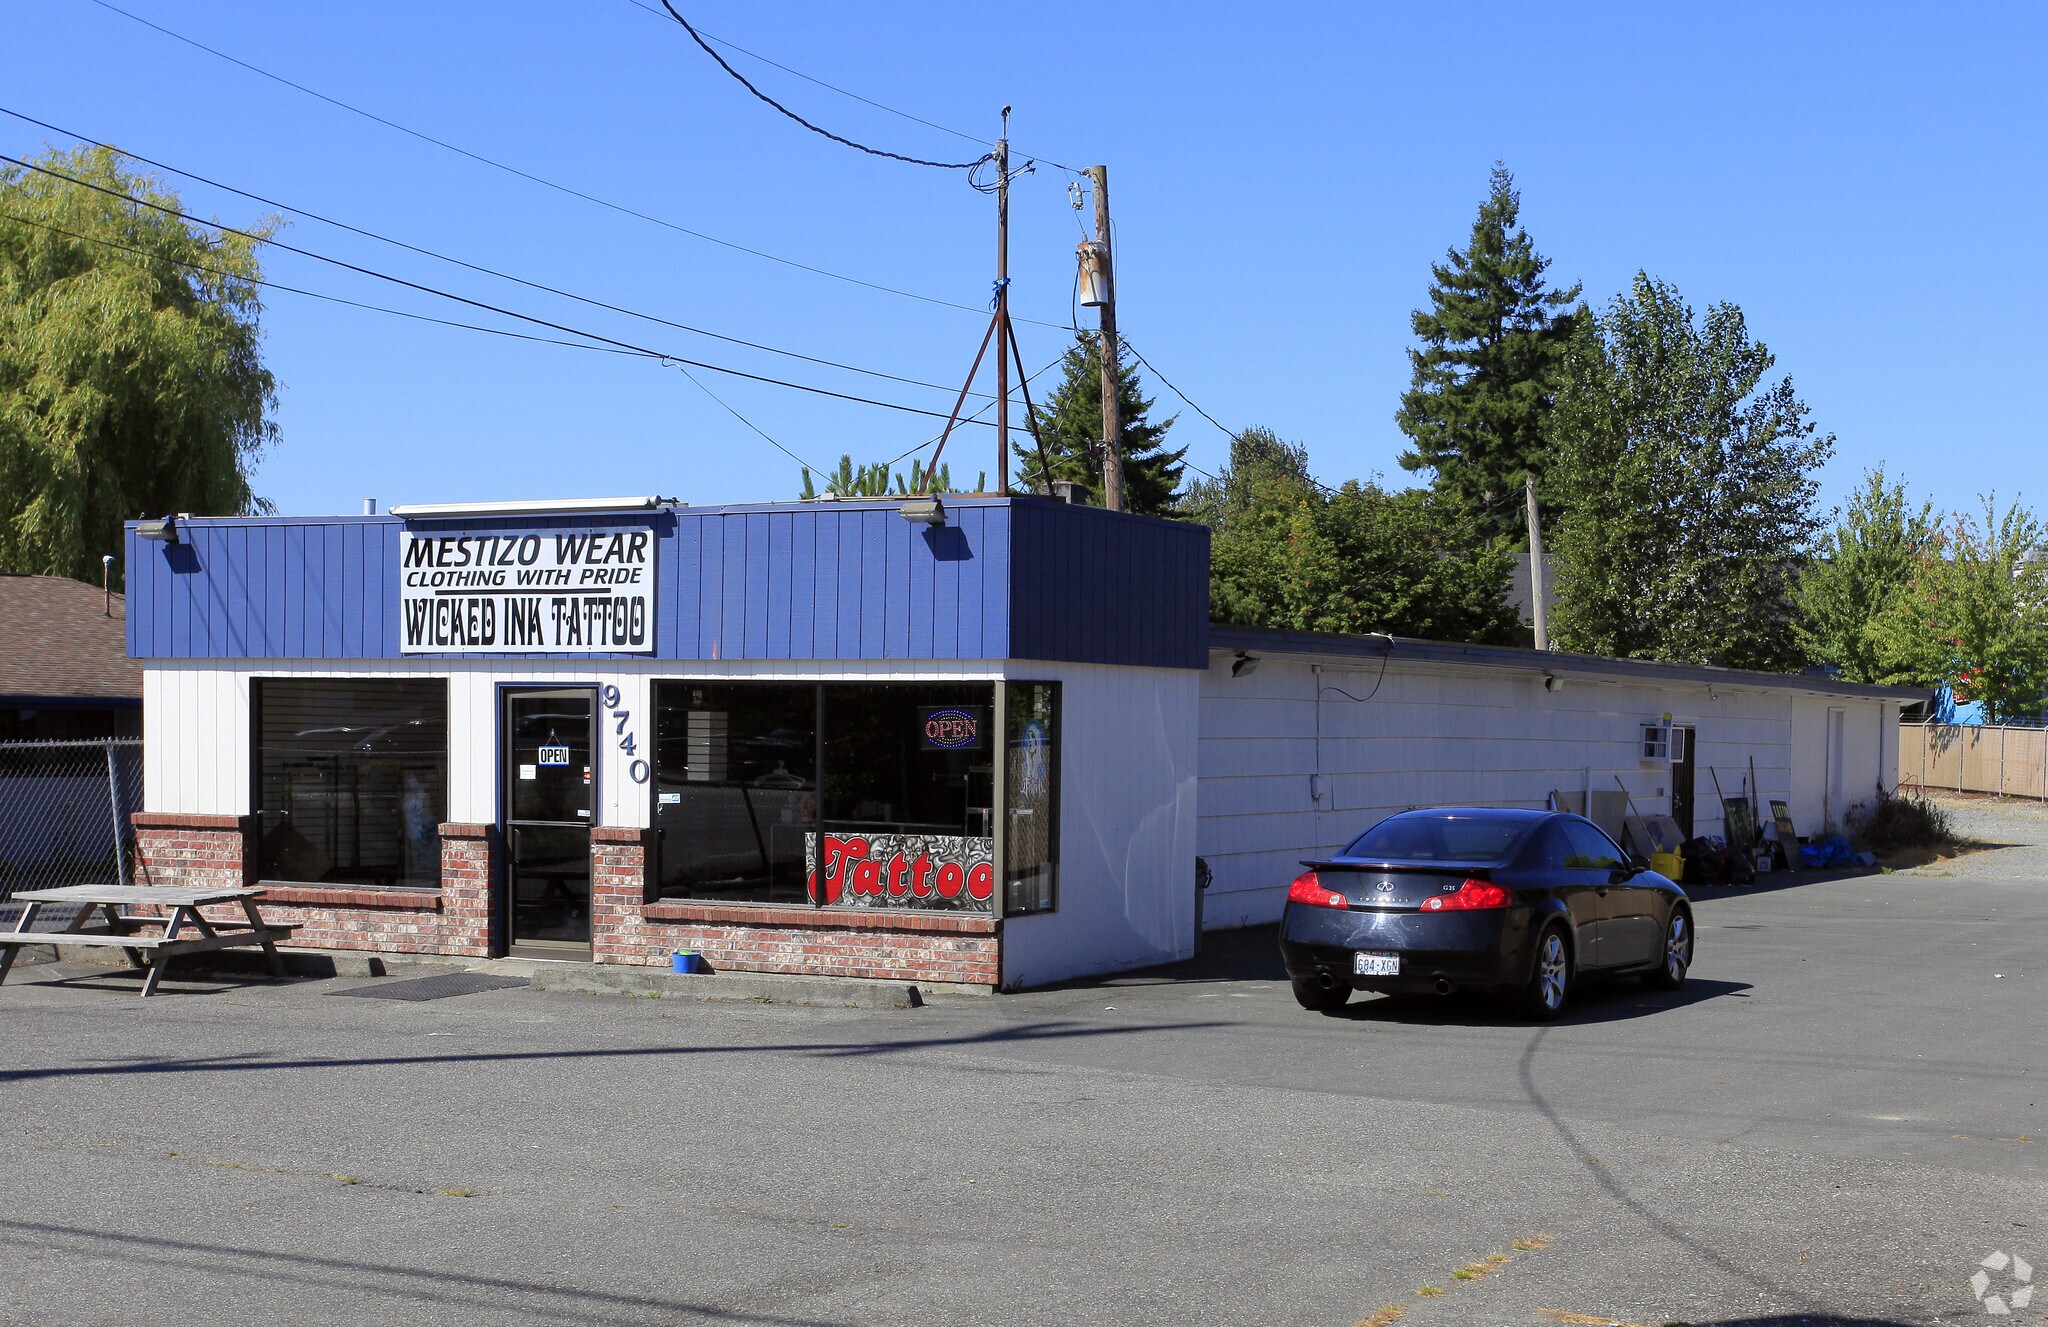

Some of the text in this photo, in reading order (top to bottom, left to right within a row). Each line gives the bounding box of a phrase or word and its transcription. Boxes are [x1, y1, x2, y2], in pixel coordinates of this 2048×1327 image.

[403, 532, 648, 568] MESTIZO WEAR
[406, 567, 643, 587] CLOTHING WITH PRIDE
[404, 596, 645, 646] WICKED INK TATTOO
[925, 720, 978, 738] OPEN
[540, 748, 567, 763] OPEN
[808, 836, 993, 906] Tattoo
